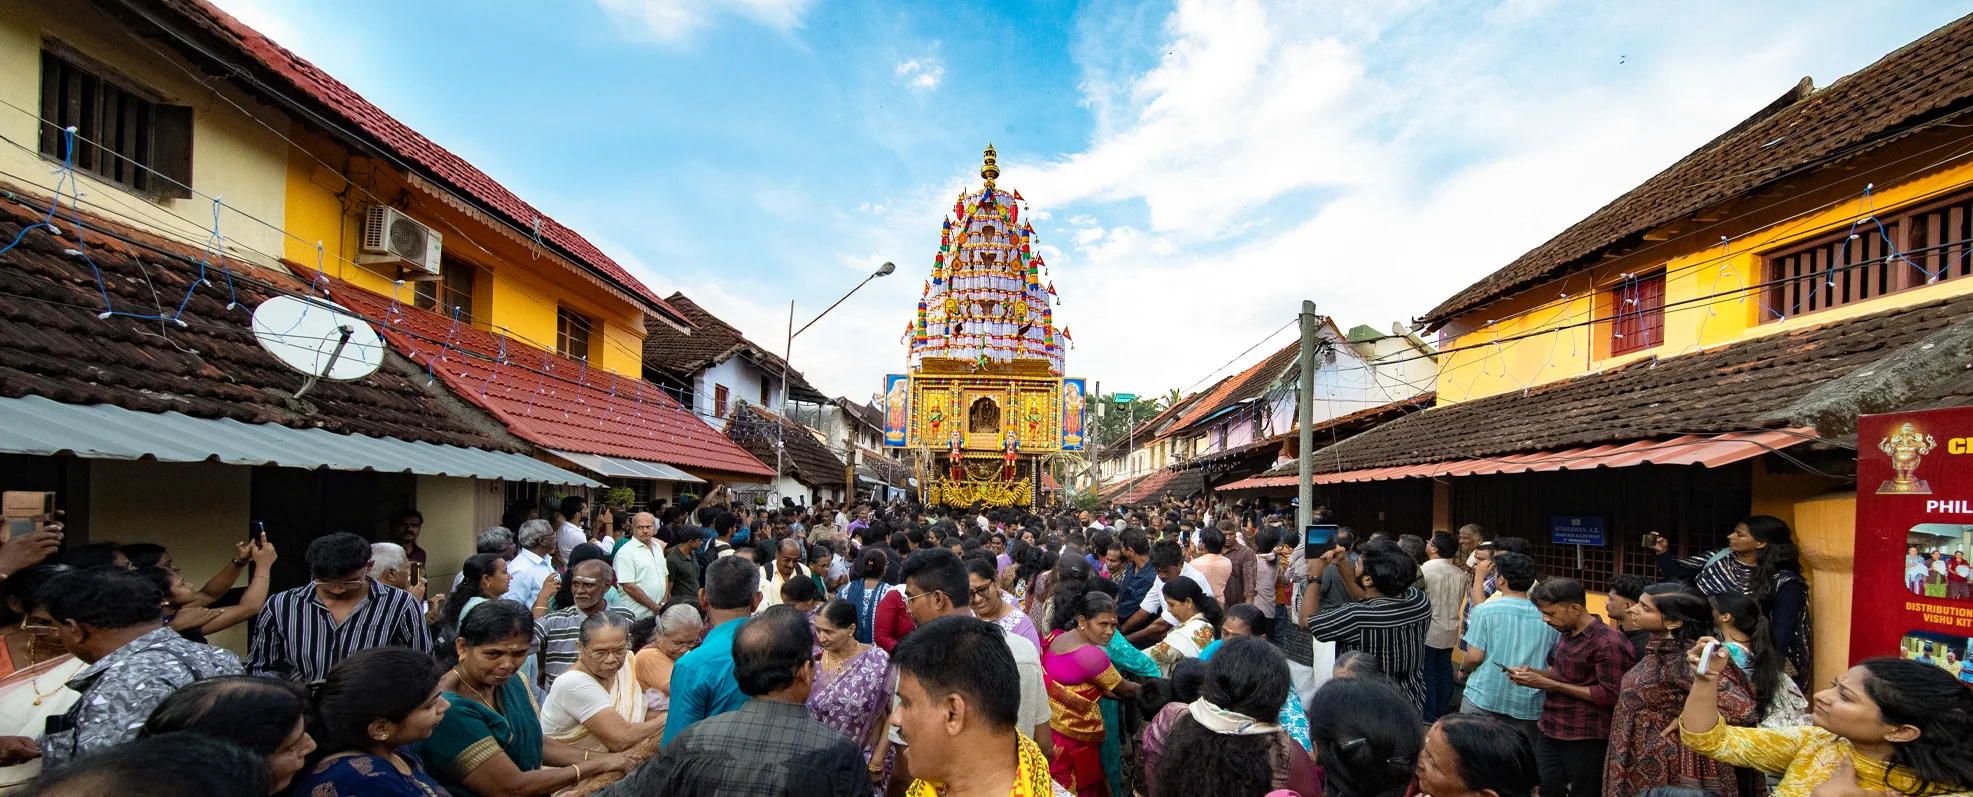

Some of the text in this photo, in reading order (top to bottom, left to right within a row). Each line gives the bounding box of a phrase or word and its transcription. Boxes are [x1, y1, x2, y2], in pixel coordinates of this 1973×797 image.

[1926, 500, 1973, 513] PHIL
[1905, 602, 1973, 617] DISTRIBUTION
[1923, 613, 1972, 627] VISHU KIT
